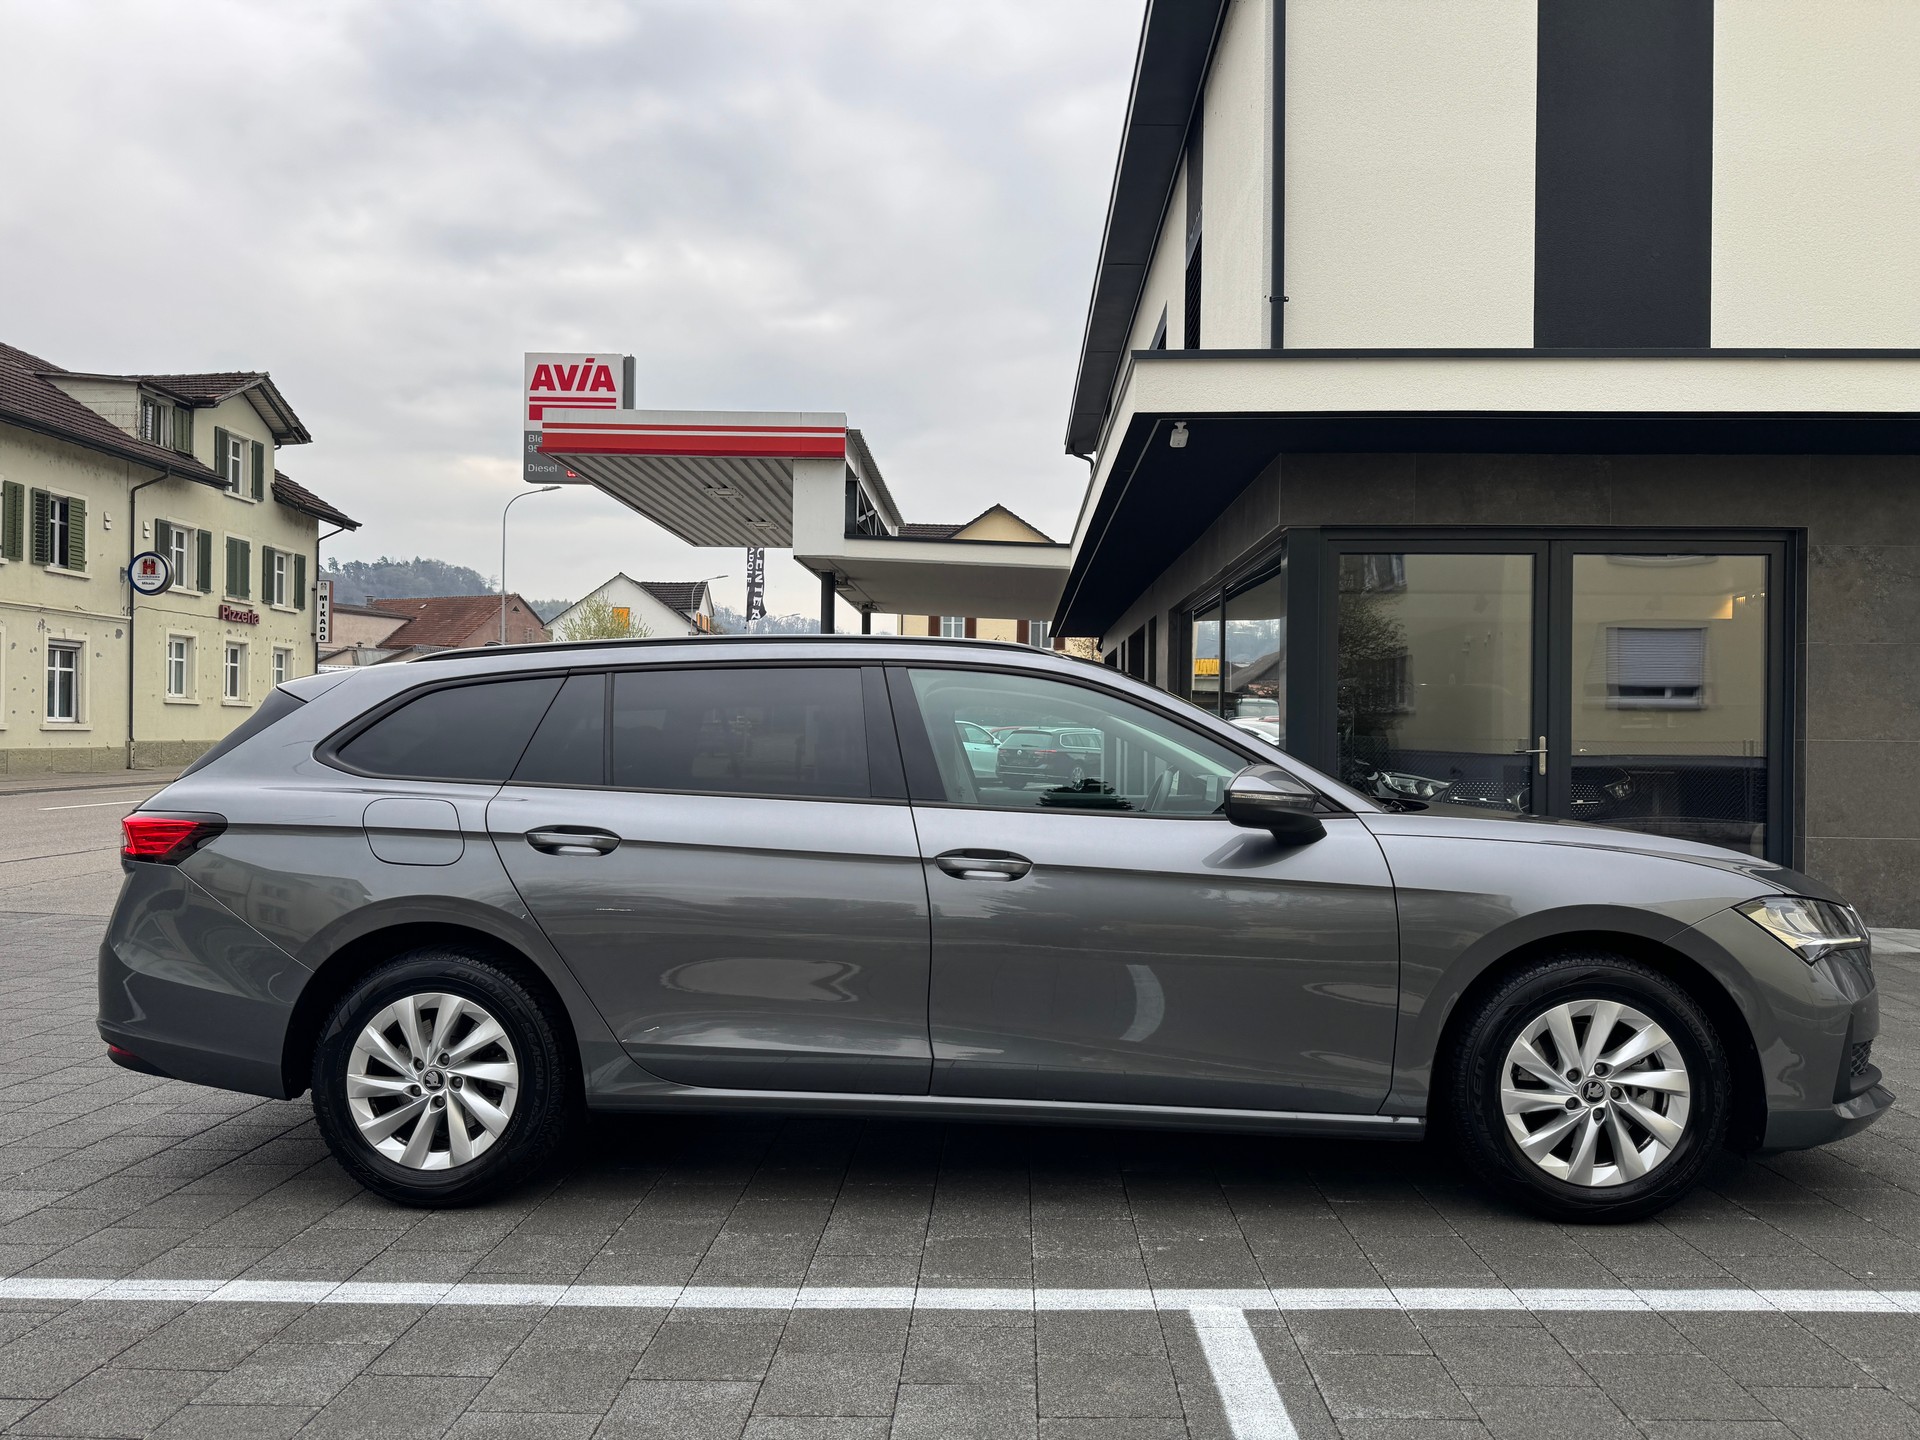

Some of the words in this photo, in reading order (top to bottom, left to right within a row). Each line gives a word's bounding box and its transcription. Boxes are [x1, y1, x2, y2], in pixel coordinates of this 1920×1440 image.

[527, 463, 558, 473] Diesel
[221, 604, 260, 624] Pizzeria
[319, 595, 328, 641] MIKADO
